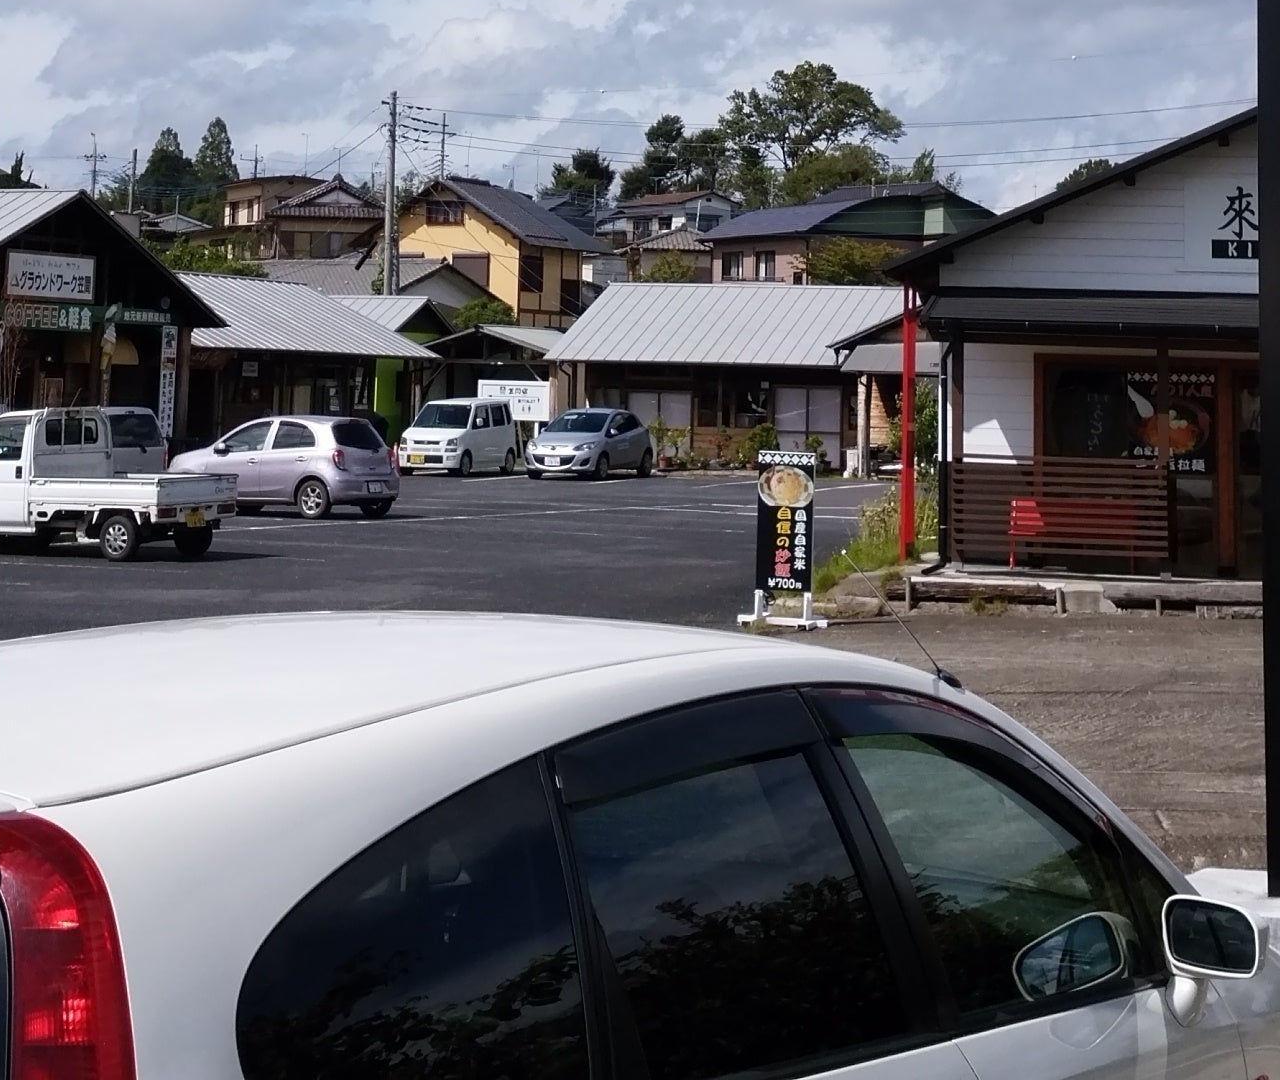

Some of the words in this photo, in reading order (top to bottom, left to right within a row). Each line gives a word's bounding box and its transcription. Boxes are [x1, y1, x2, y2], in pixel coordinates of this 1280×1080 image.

[774, 506, 792, 577] 自信の炒飯
[794, 509, 807, 570] 国産自家米
